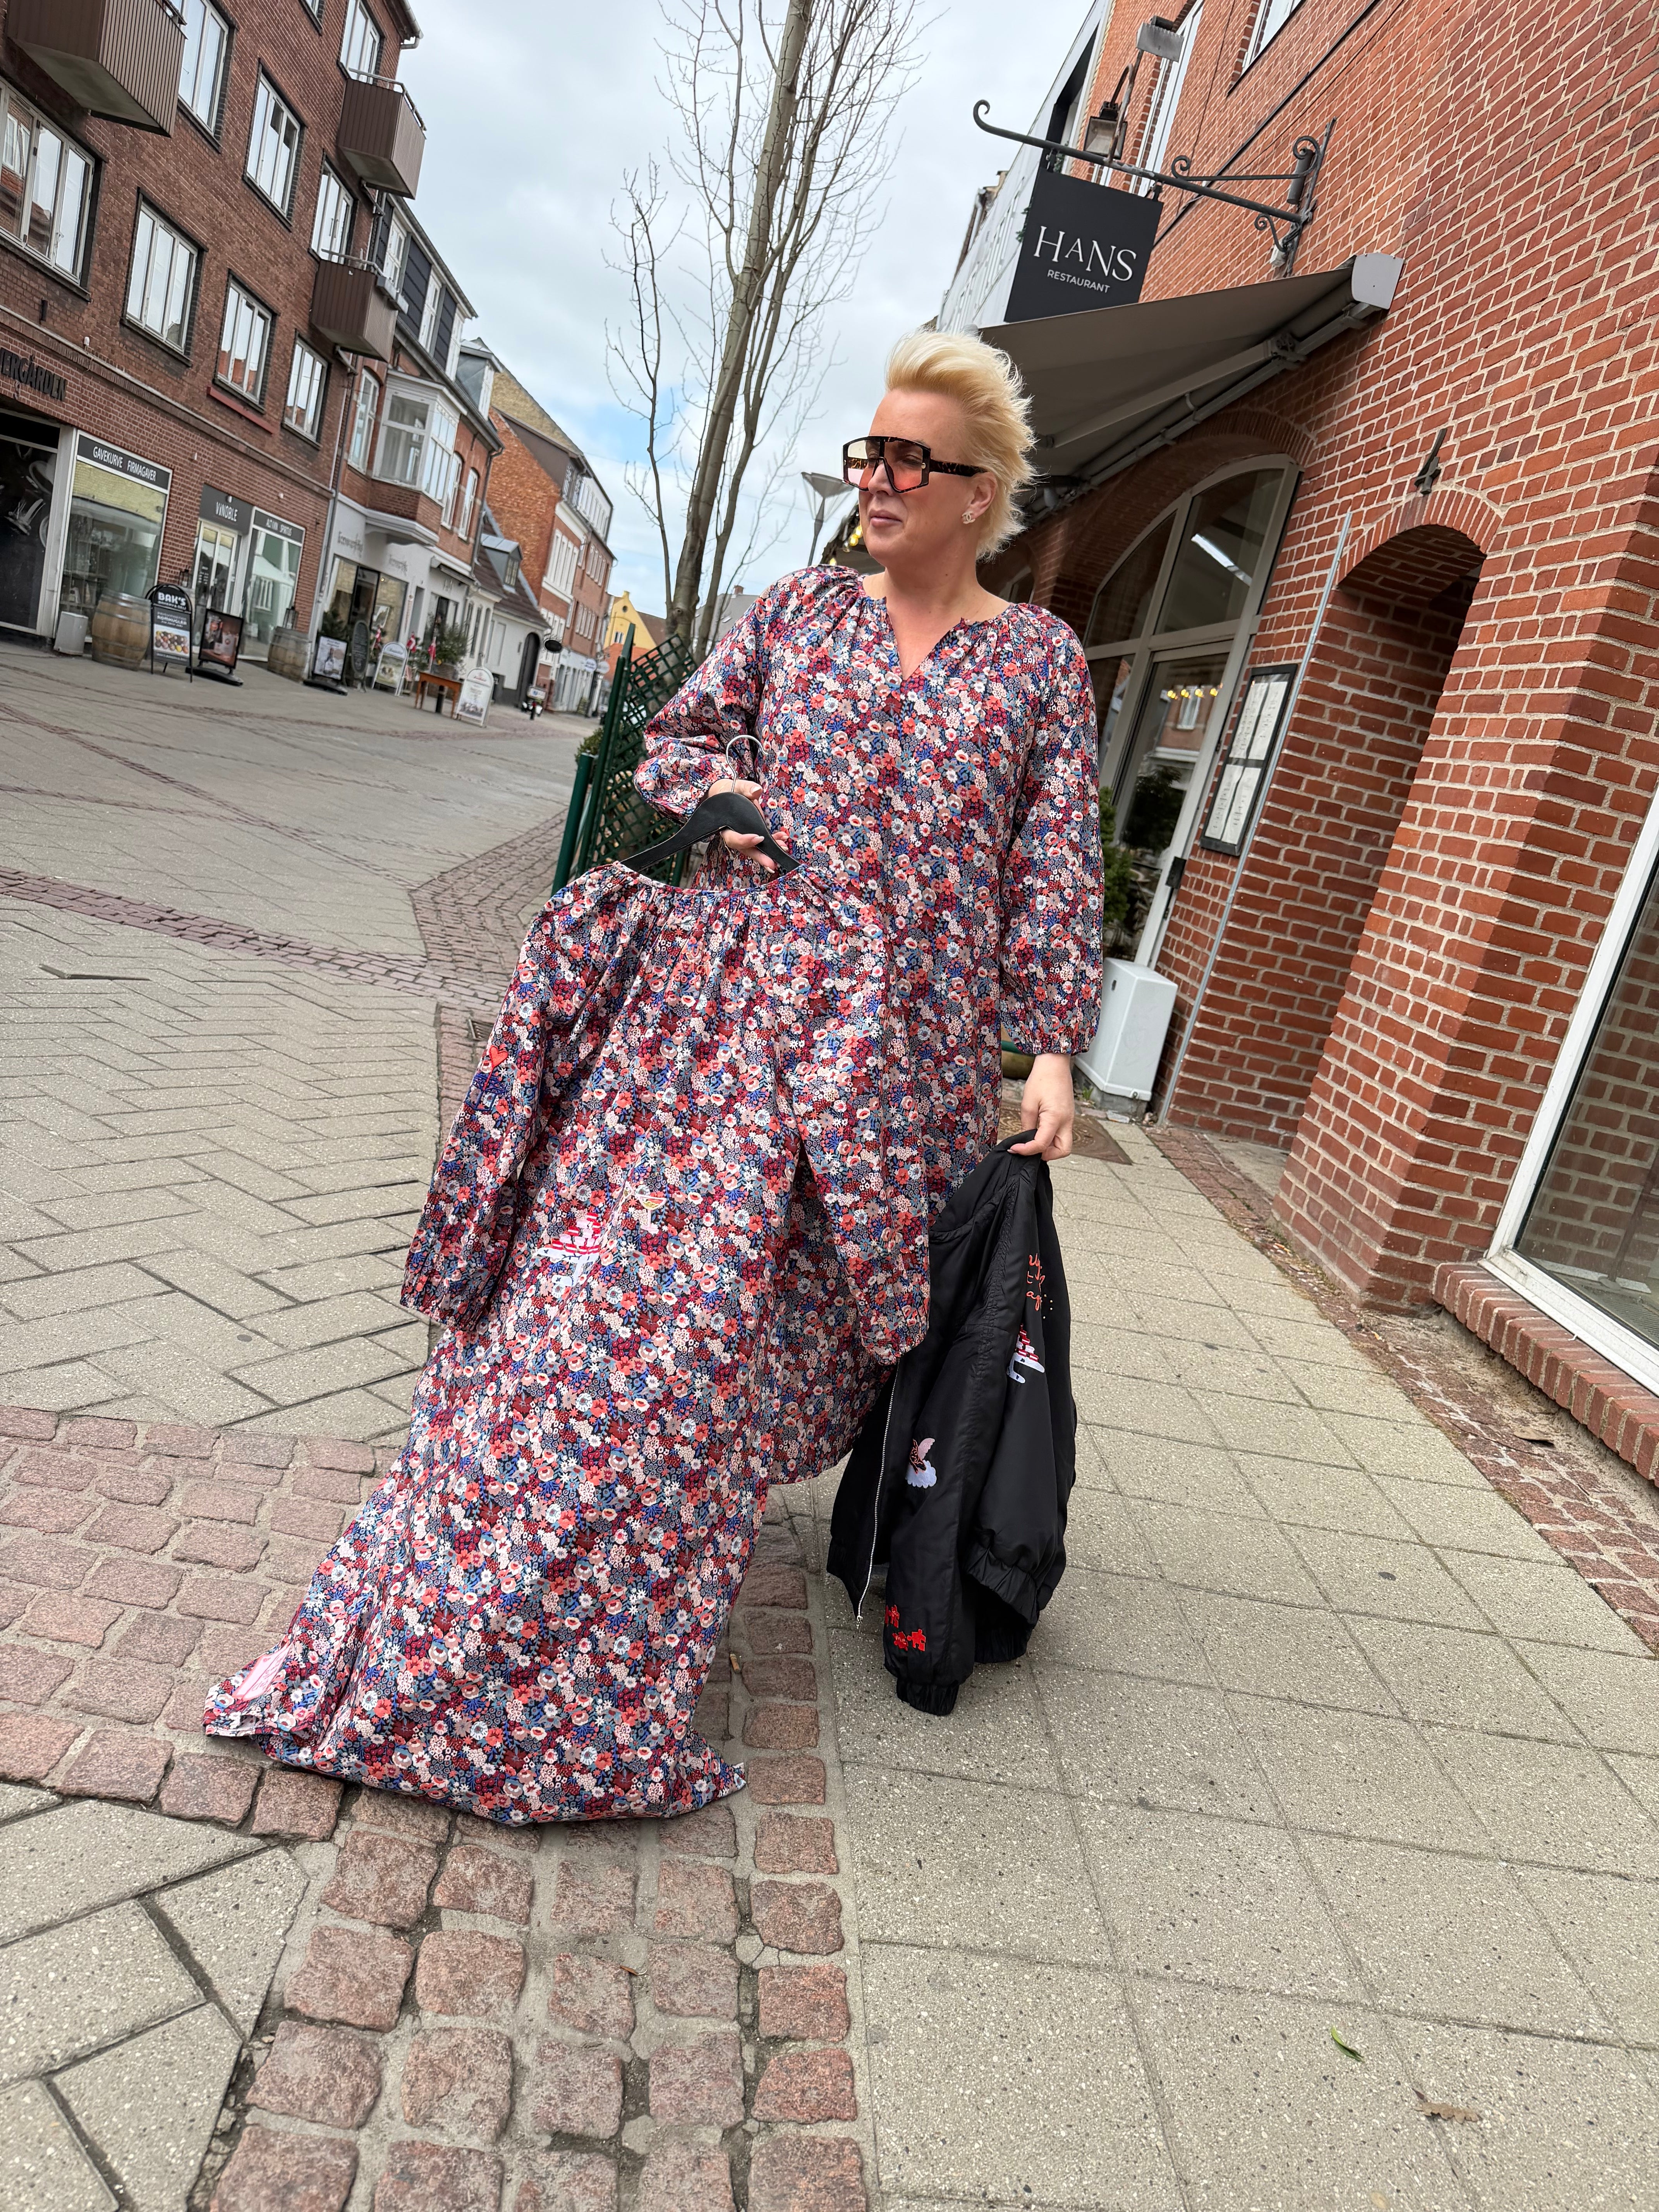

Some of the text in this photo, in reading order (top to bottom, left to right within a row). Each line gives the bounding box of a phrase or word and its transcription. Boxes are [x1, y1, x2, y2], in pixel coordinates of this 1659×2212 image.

[1034, 226, 1137, 281] HANS
[1047, 269, 1110, 293] RESTAURANT
[93, 446, 156, 481] GAVEKURVE FIRMAGAVER
[216, 502, 238, 522] VINOBLE
[158, 591, 186, 606] BAK'S
